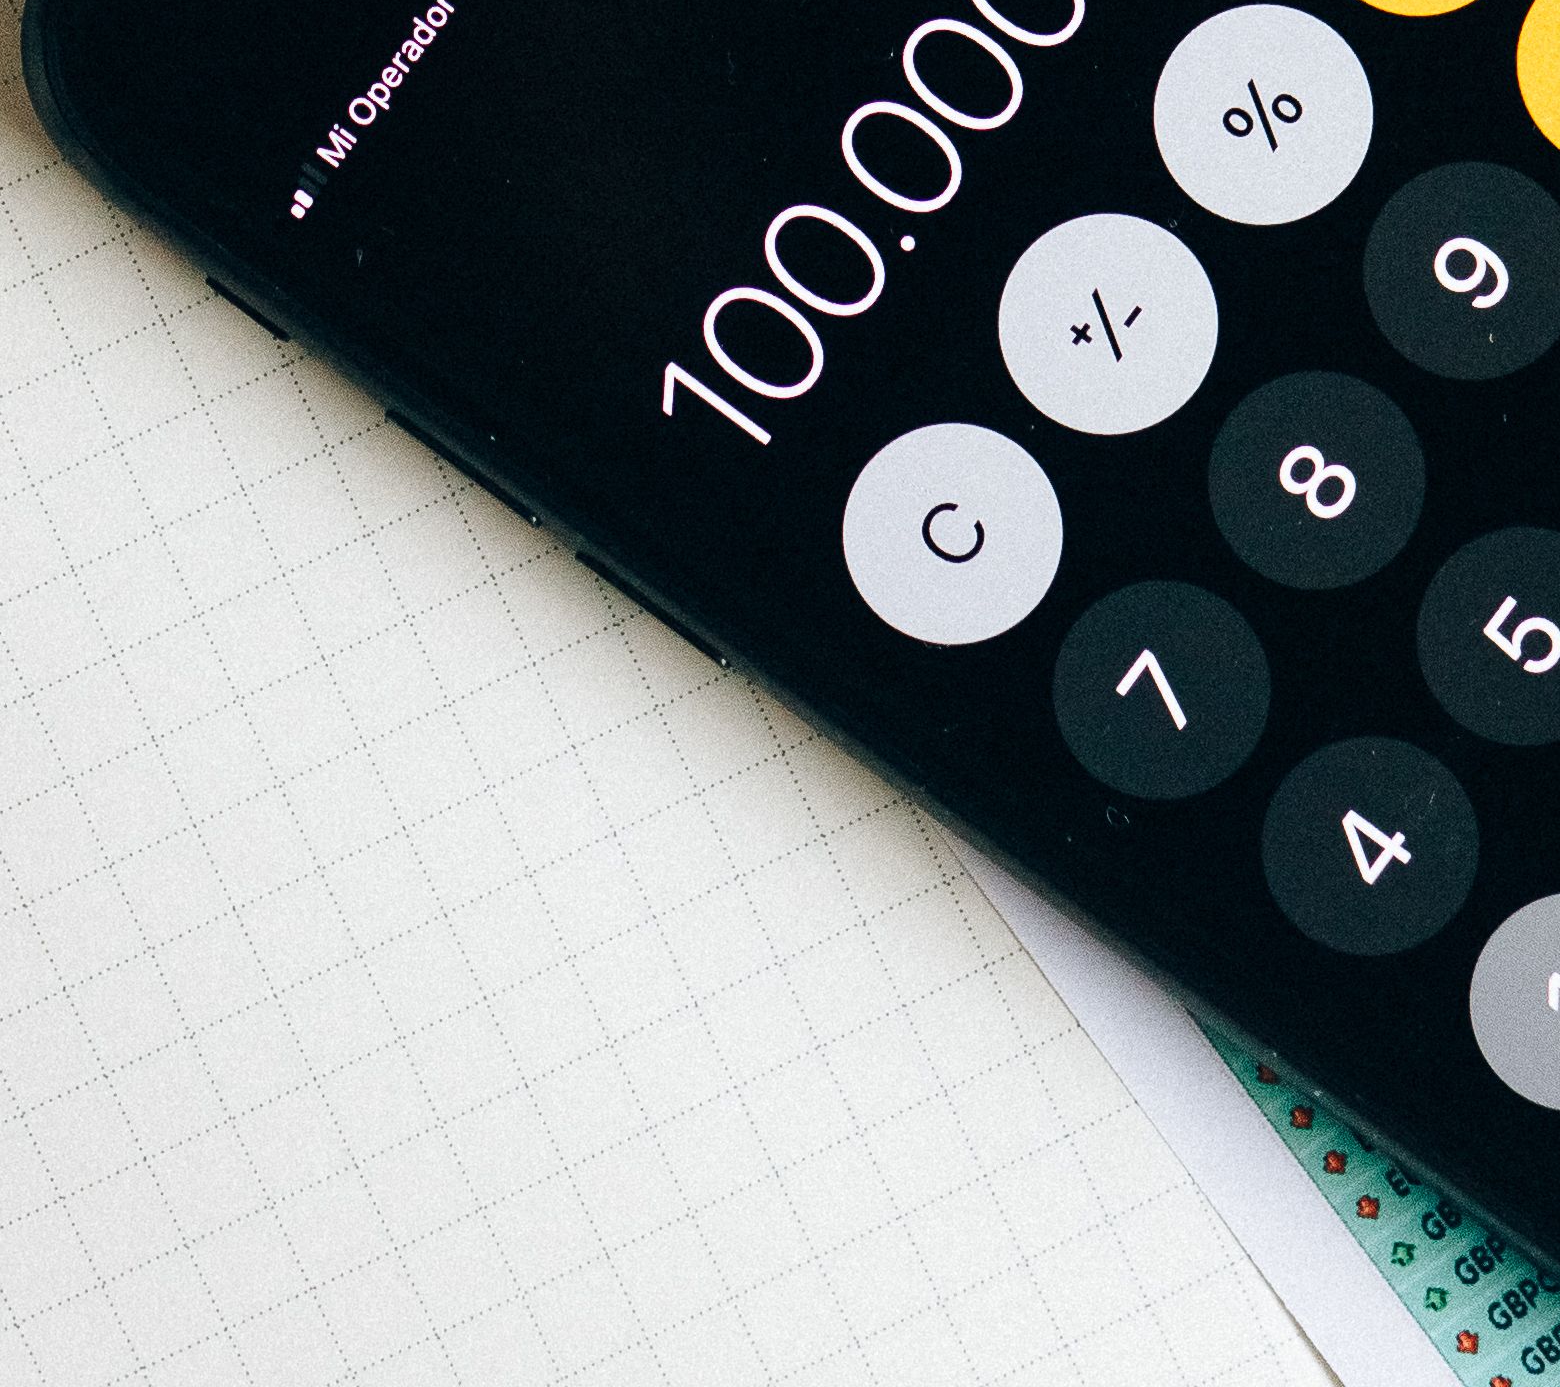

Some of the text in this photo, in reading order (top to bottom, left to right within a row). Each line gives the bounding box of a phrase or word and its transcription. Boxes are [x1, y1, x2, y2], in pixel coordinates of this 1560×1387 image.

[316, 123, 358, 168] Mi
[1222, 79, 1303, 152] %
[1434, 238, 1509, 308] 9
[1280, 446, 1356, 518] 8
[922, 503, 984, 563] C
[1116, 650, 1186, 729] 7
[1342, 810, 1411, 884] 4
